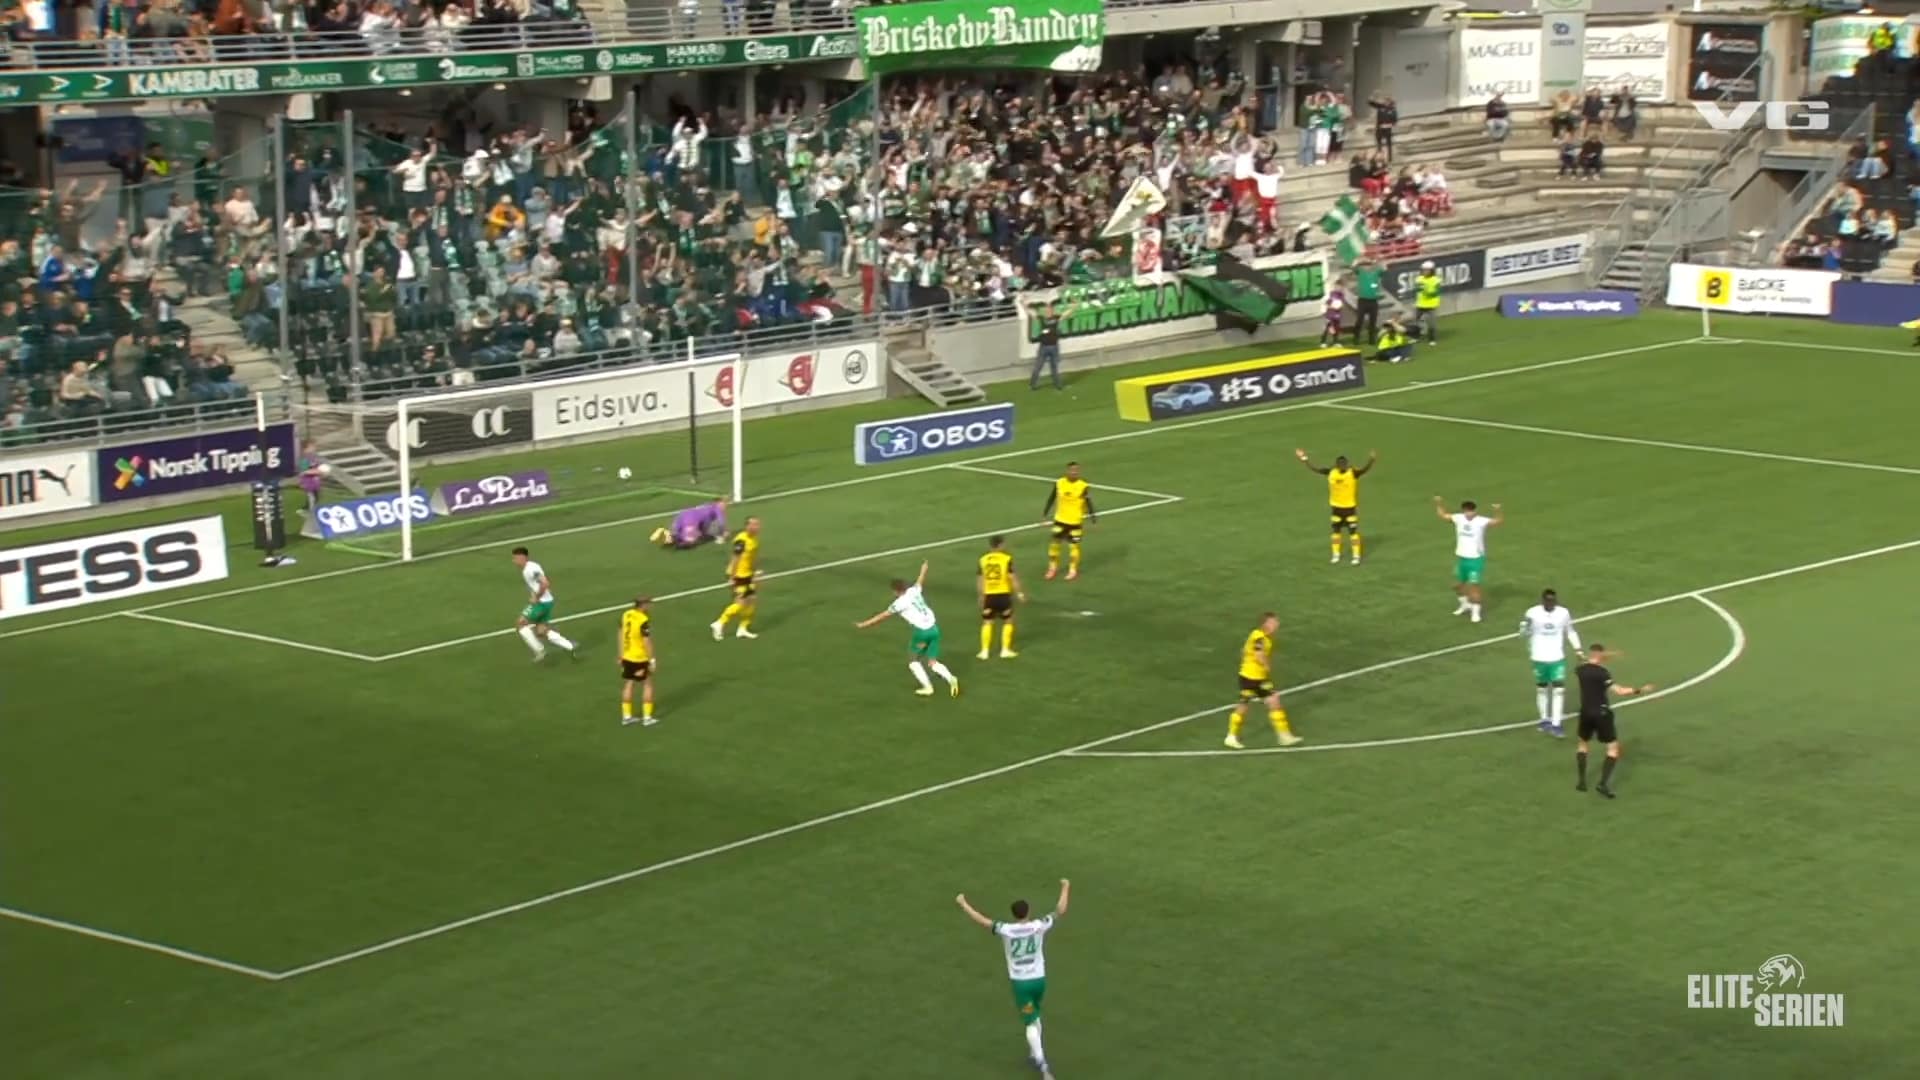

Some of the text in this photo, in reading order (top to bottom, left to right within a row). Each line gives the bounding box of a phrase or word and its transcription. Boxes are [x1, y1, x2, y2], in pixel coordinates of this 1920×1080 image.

[129, 68, 259, 96] KAMERATER
[1219, 363, 1357, 402] #5 smart
[921, 418, 1006, 449] OBOS
[150, 455, 207, 480] Norsk
[451, 475, 549, 512] La Perla
[1010, 935, 1036, 958] 24
